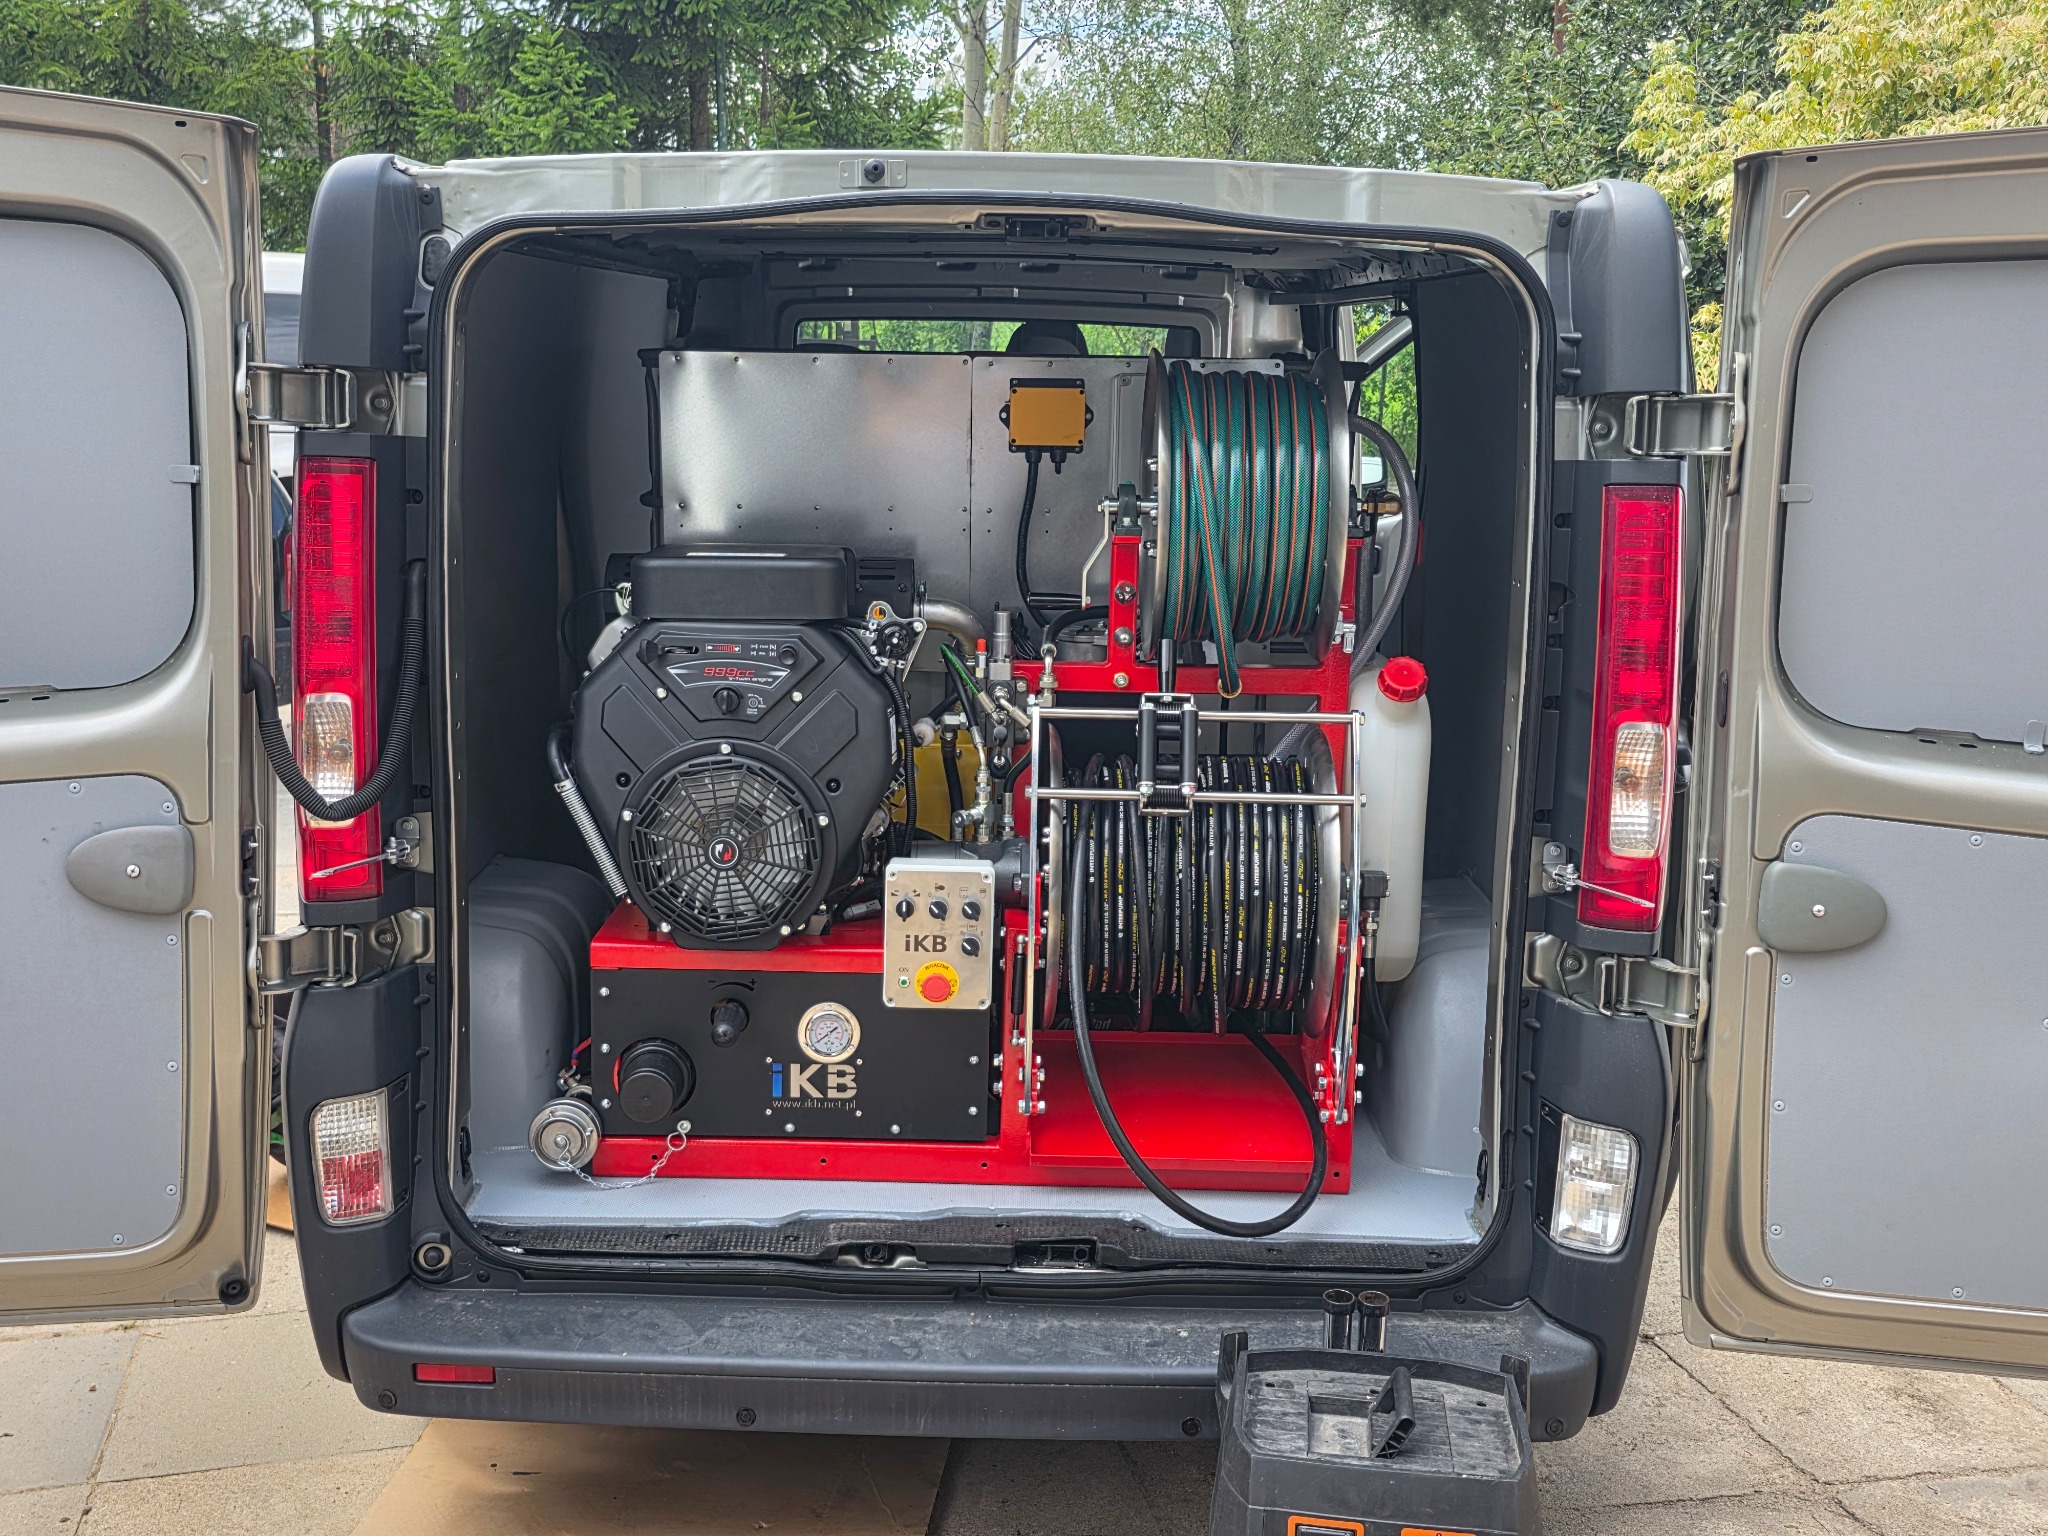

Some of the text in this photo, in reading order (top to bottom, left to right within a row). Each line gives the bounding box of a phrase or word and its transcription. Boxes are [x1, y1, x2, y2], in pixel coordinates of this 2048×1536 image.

[703, 667, 755, 677] 999cc
[905, 934, 948, 953] iKB
[772, 1063, 858, 1098] iKB
[772, 1098, 856, 1111] www.ikb.net.pl
